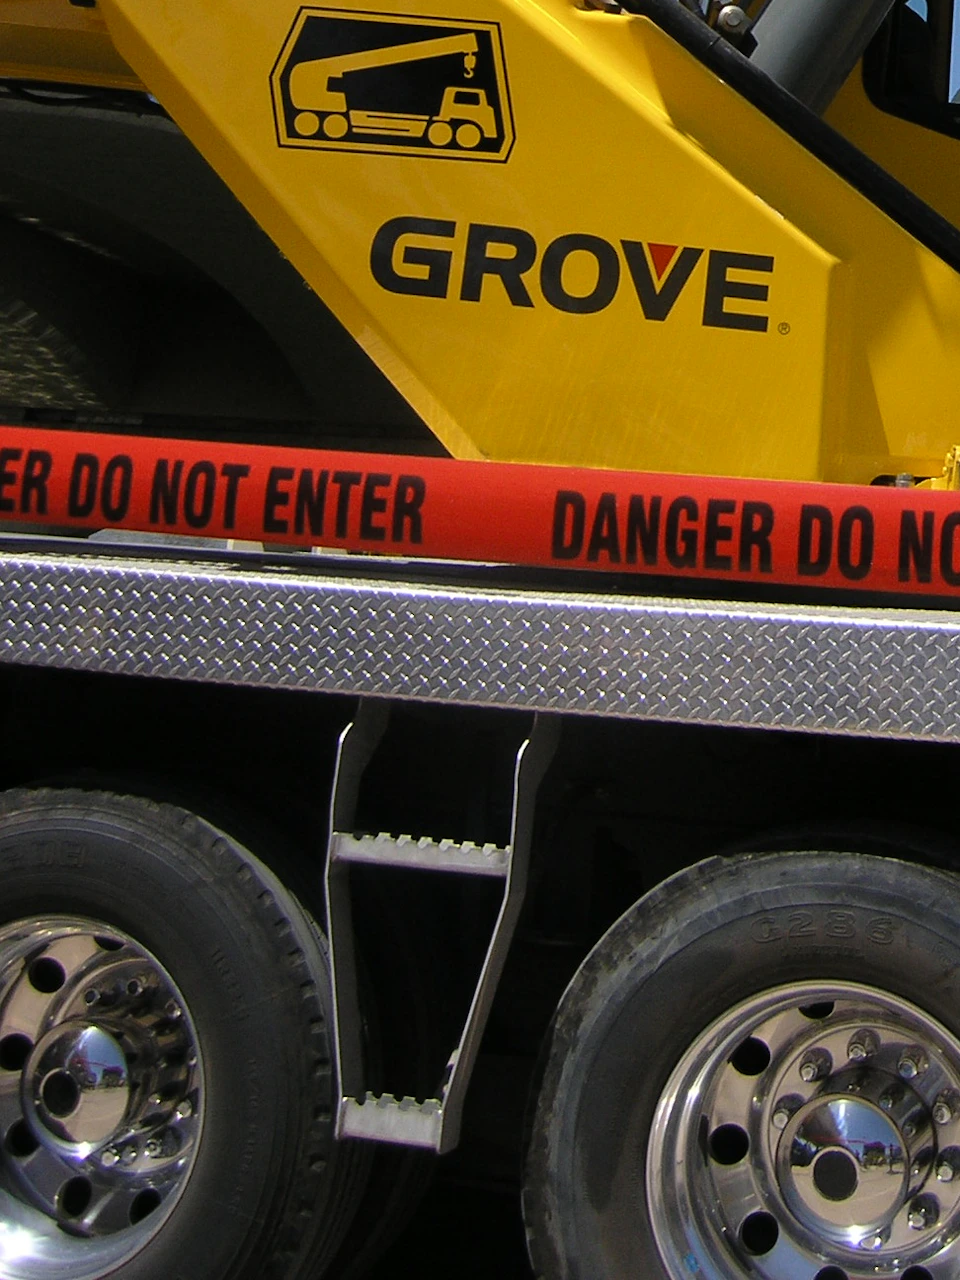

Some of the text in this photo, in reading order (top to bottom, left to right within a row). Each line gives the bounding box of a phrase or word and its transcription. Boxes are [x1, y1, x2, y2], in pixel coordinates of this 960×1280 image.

[369, 216, 775, 333] GROVE
[68, 452, 134, 522] DO
[150, 457, 249, 529] NOT
[263, 466, 426, 545] ENTER
[551, 489, 775, 575] DANGER
[796, 503, 875, 581] DO
